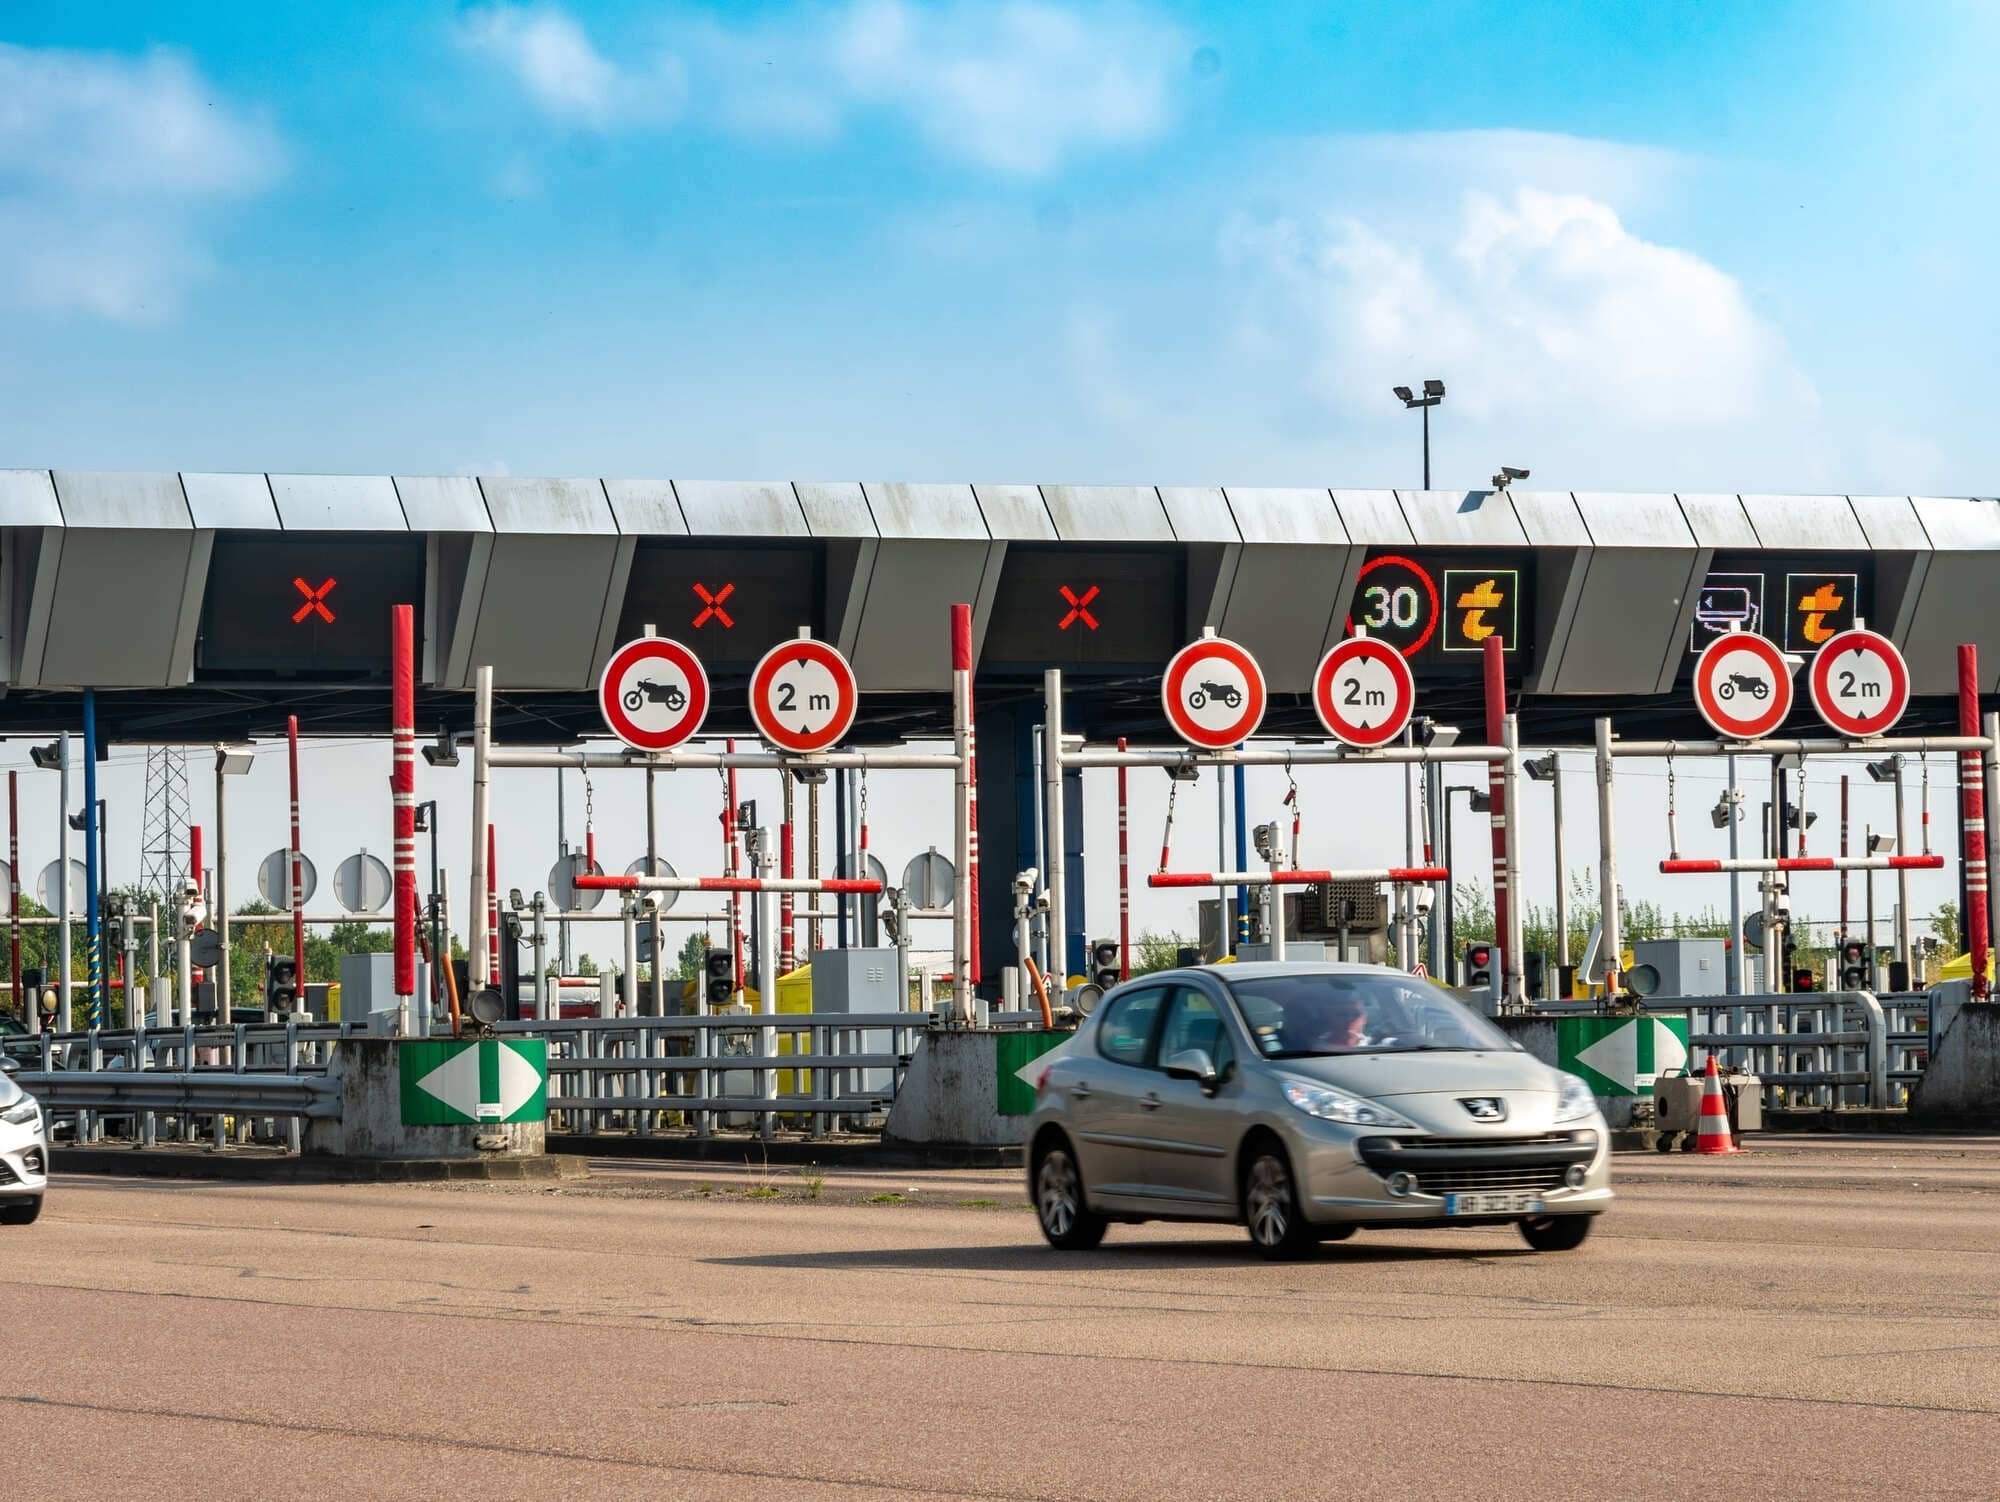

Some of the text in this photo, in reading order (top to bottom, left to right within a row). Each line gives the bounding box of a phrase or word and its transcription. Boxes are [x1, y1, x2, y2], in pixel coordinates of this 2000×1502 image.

[1364, 587, 1418, 627] 30
[777, 683, 831, 711] 2 m
[1344, 678, 1385, 705] 2 m
[1839, 671, 1881, 697] 2 m
